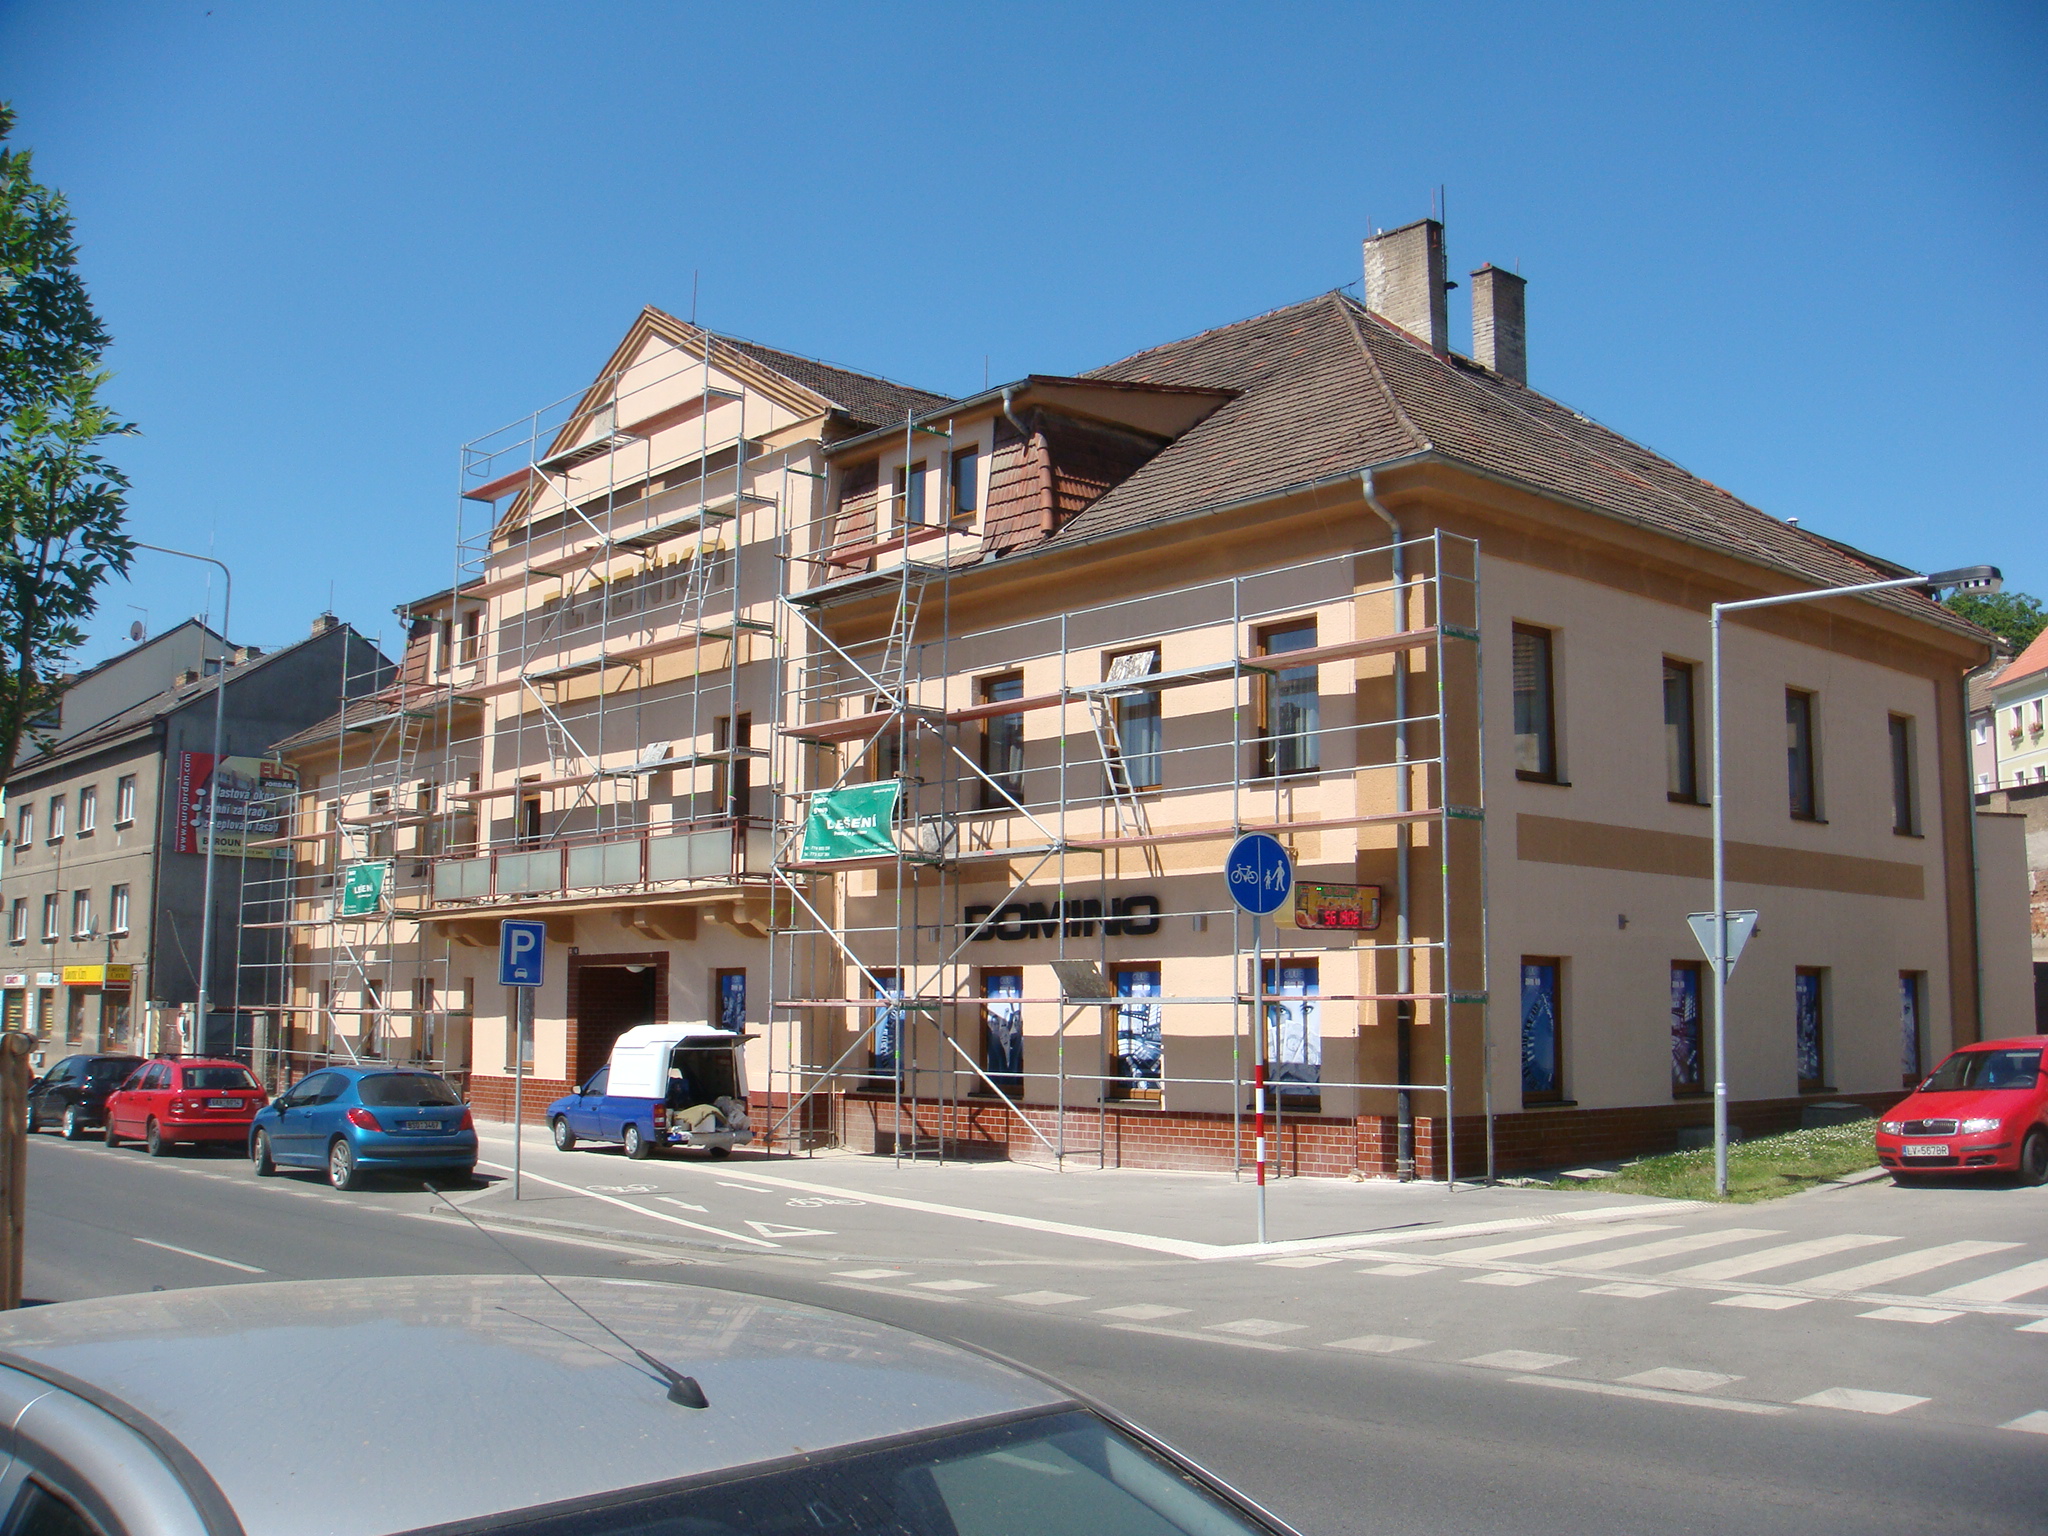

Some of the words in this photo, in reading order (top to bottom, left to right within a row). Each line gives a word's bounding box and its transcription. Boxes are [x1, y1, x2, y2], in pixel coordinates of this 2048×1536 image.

[180, 753, 191, 852] www.eurojordan.com
[214, 786, 251, 799] lastová
[205, 804, 231, 815] zmní
[203, 836, 241, 847] BROUN
[964, 895, 1160, 941] DOMINO
[511, 929, 535, 965] P
